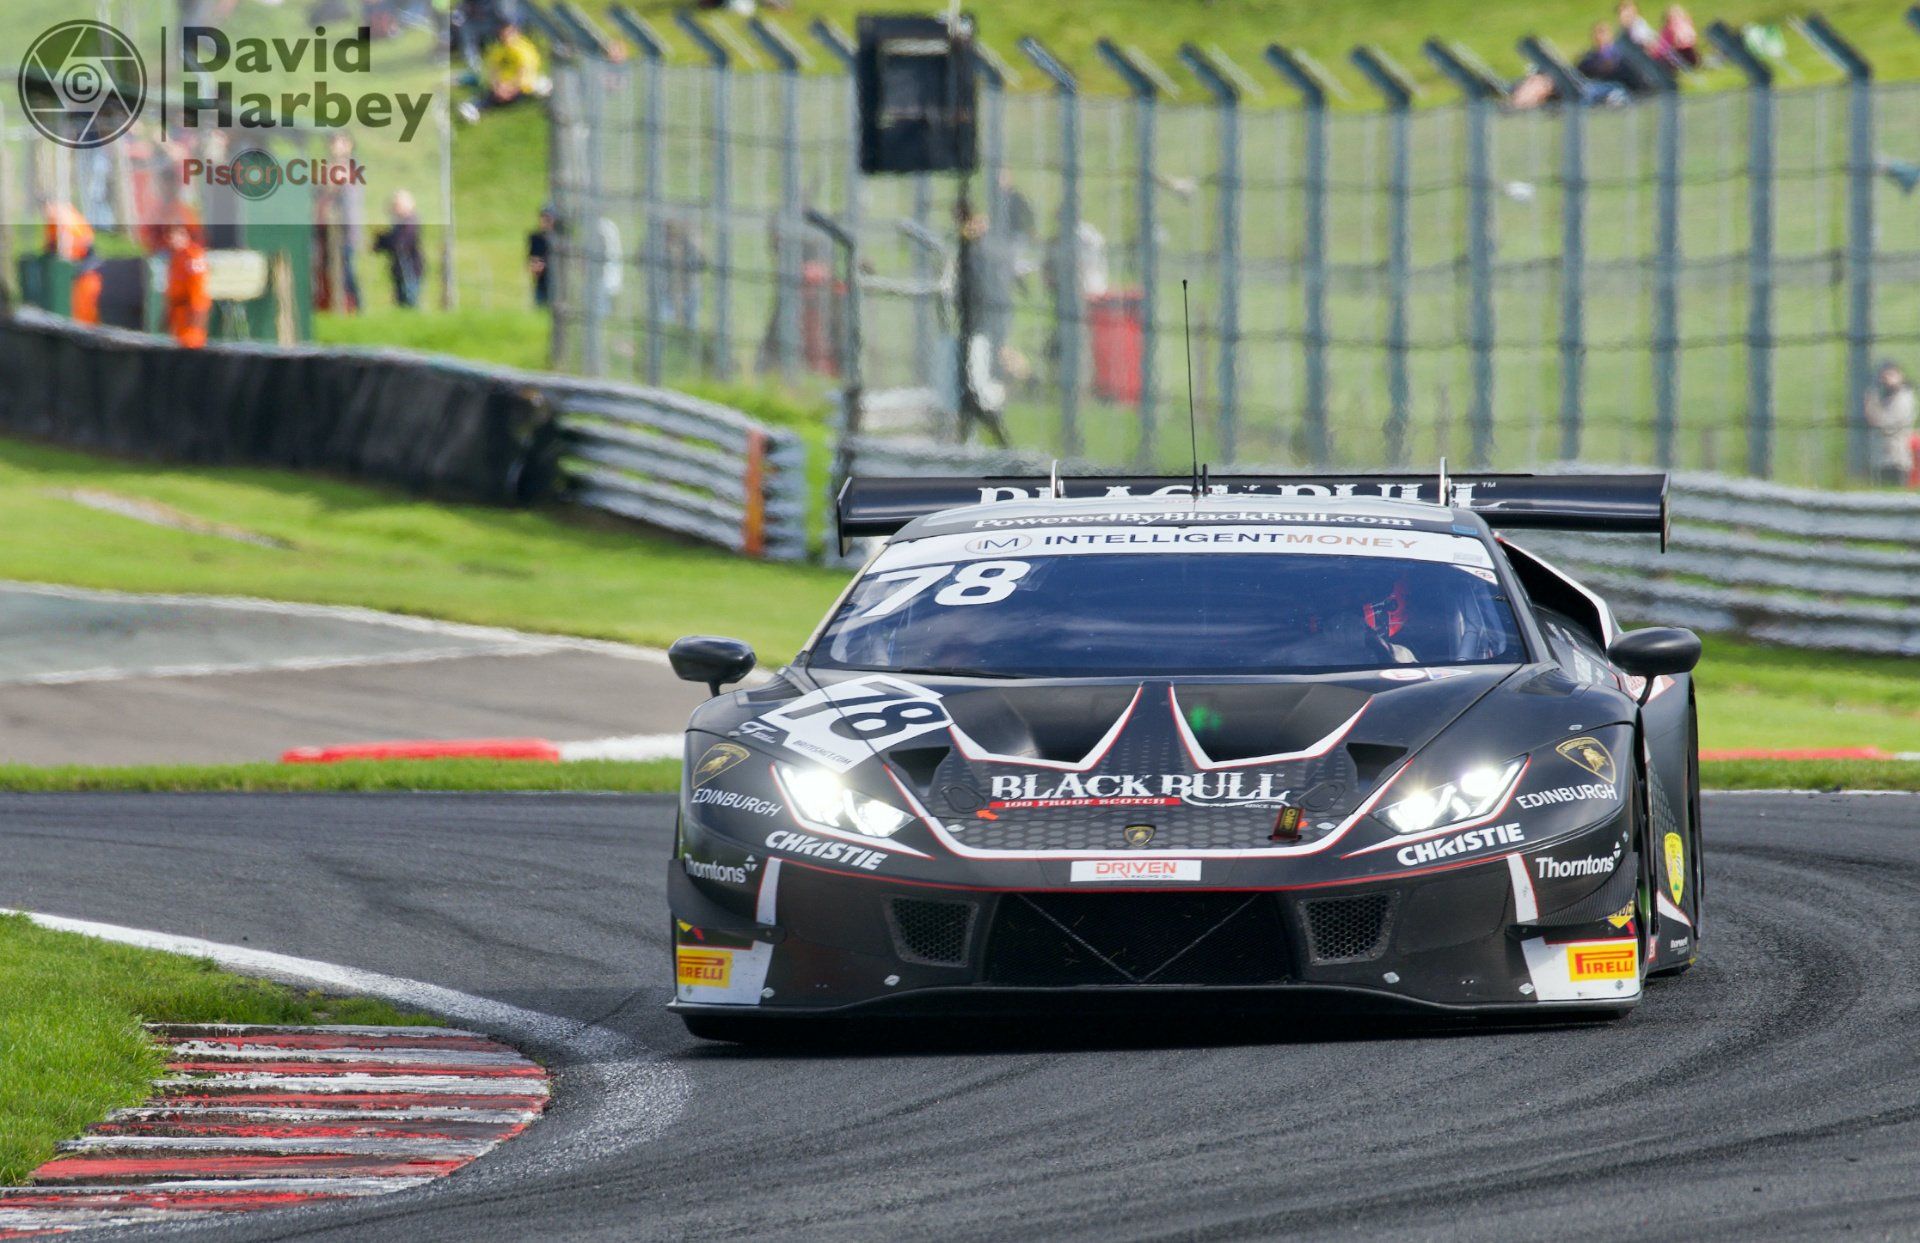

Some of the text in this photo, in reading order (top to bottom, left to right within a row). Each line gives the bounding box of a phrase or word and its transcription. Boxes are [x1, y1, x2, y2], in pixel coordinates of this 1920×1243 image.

[861, 560, 1031, 617] 78
[779, 680, 948, 740] 78
[691, 788, 783, 817] EDINBURGH
[991, 772, 1291, 806] BLACK BULL
[1099, 797, 1165, 805] SCOTCH
[1516, 784, 1617, 809] EDINBURGH
[765, 830, 888, 870] CHRISTIE
[1397, 822, 1524, 866] CHRISTIE
[1095, 862, 1177, 877] DRIVEN
[1535, 855, 1614, 879] Thorntons
[1575, 950, 1634, 974] PIRELLI
